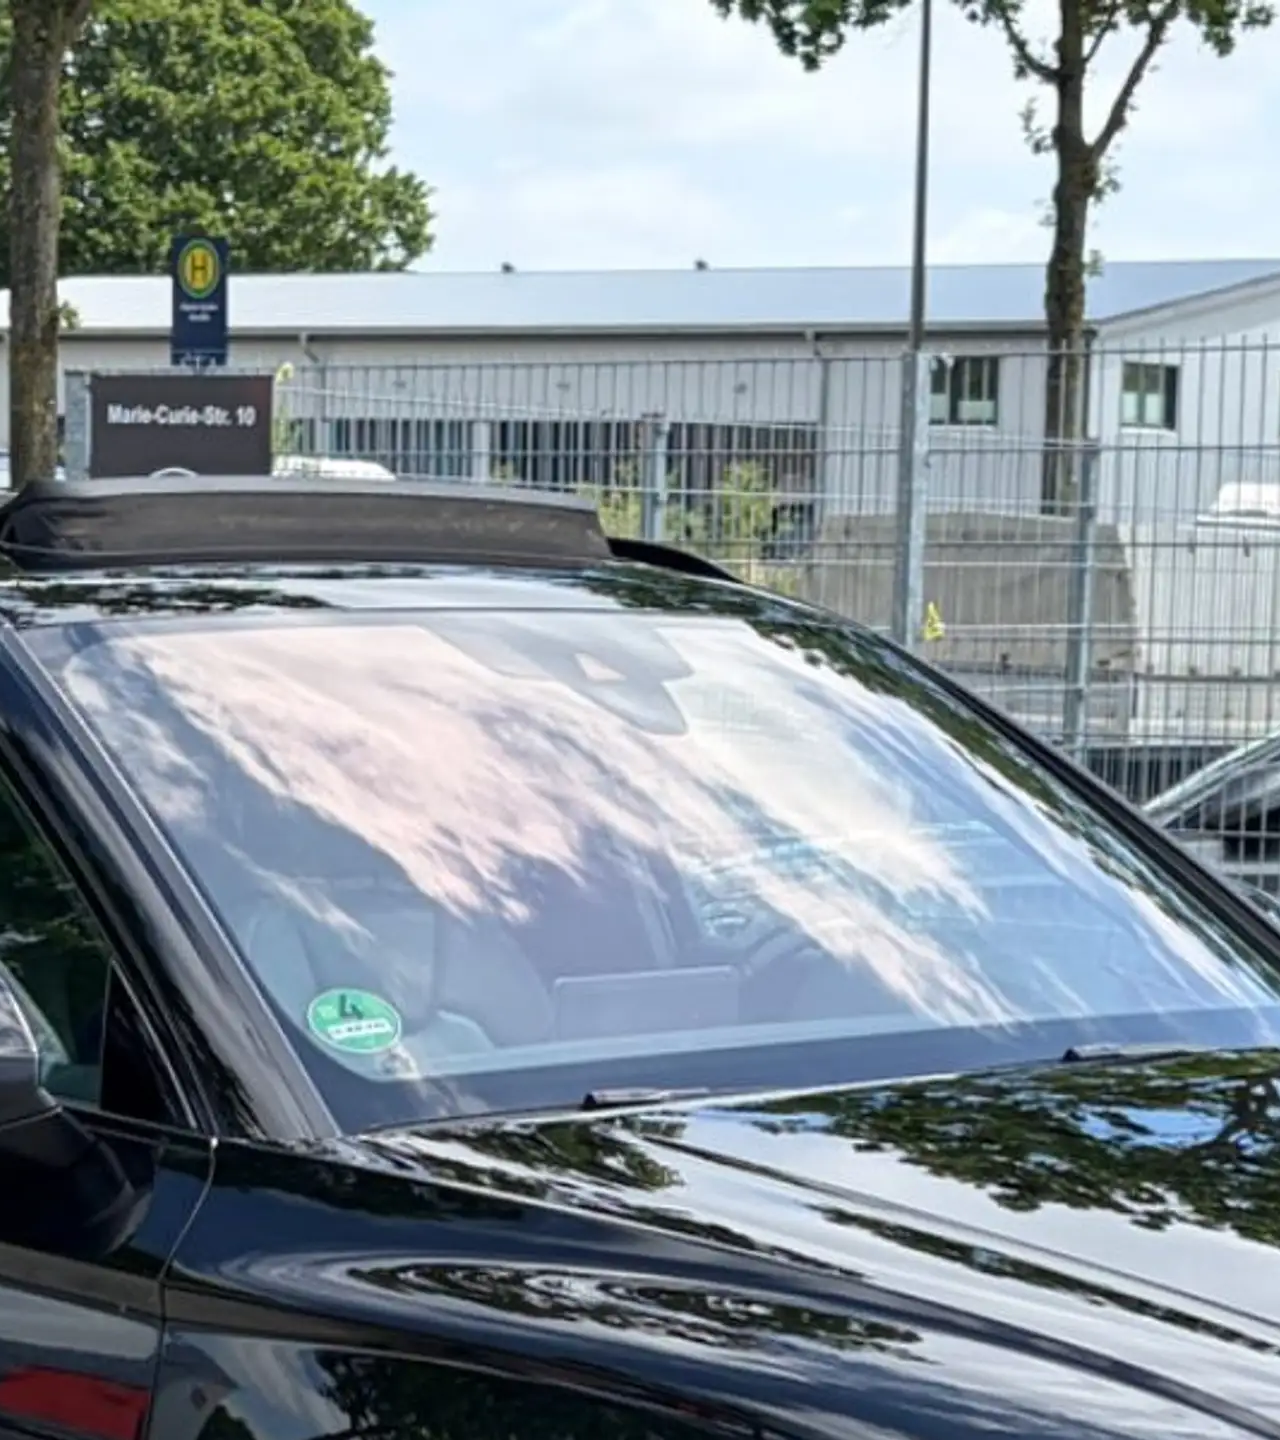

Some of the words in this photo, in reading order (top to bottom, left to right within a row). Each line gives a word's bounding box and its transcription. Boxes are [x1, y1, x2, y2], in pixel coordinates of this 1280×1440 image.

[106, 403, 232, 426] Marie-Curie-Str.
[236, 405, 257, 427] 10
[339, 993, 363, 1020] 4
